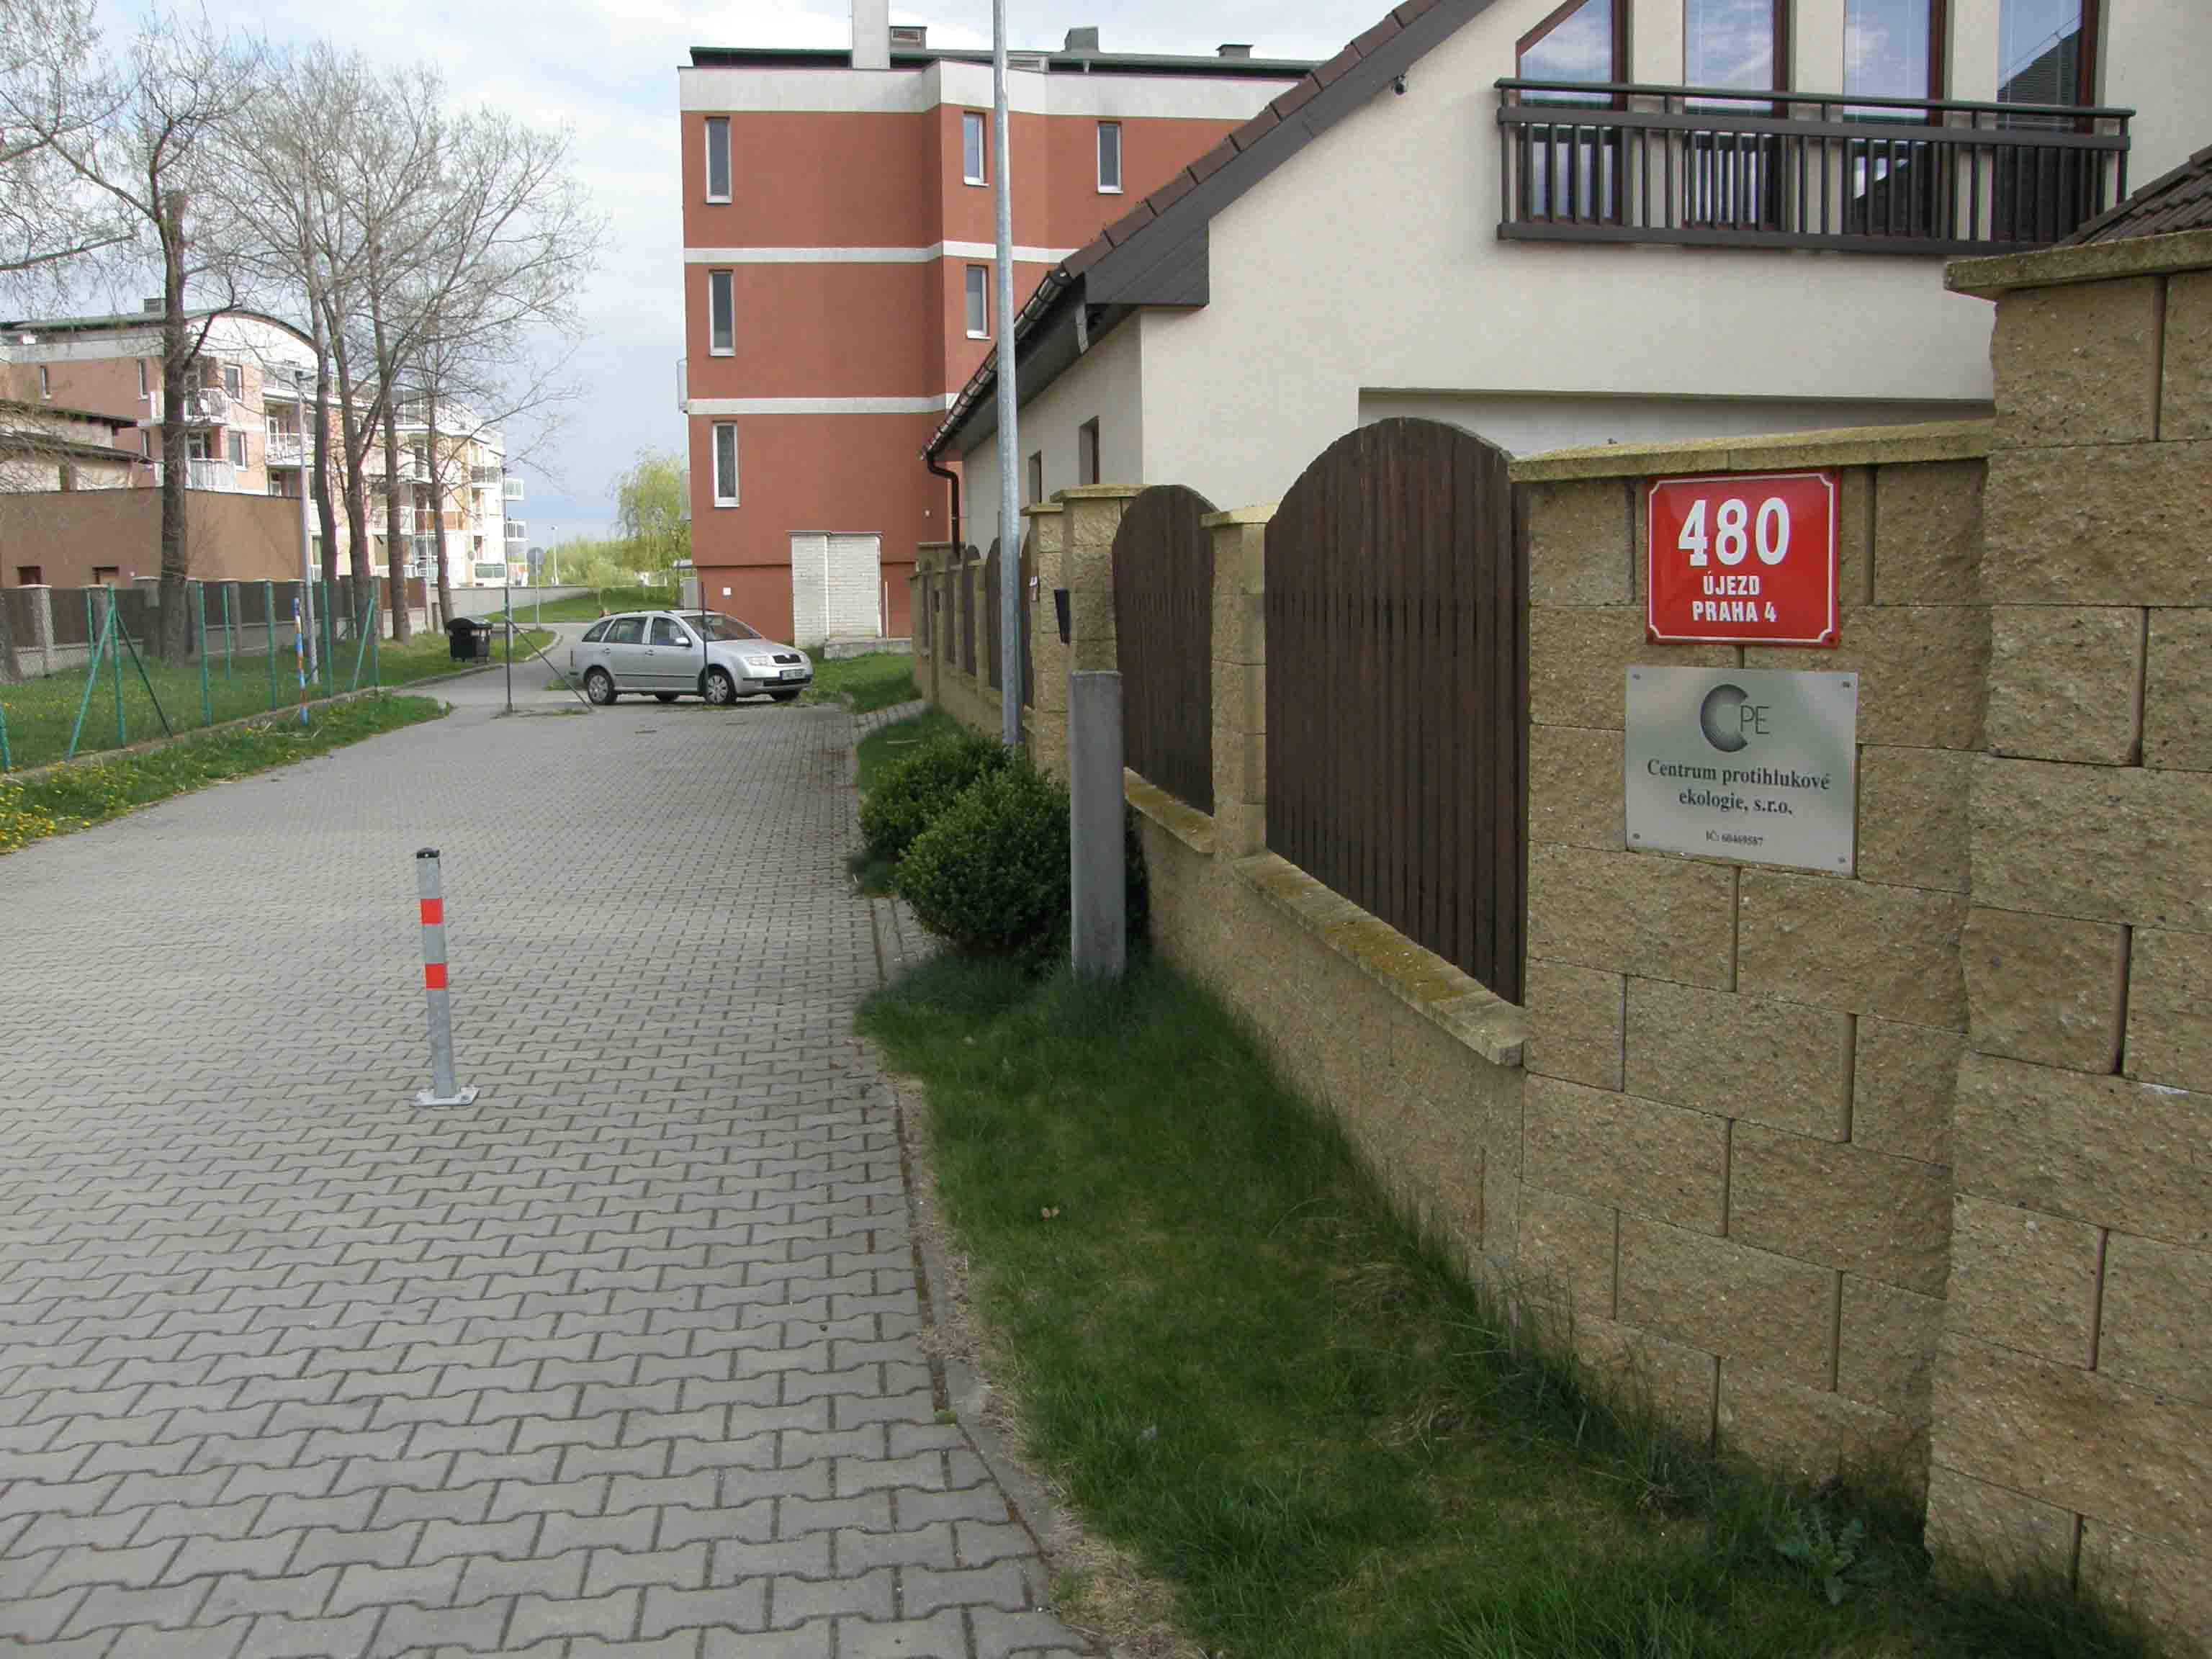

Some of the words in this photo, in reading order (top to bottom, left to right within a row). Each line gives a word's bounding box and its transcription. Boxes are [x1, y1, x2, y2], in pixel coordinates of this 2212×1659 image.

[1678, 497, 1790, 566] 480
[1703, 571, 1760, 595] ÚJEZD
[1693, 601, 1758, 621] PRAHA
[1765, 601, 1777, 622] 4
[1647, 758, 1717, 781] Centrum
[1722, 767, 1831, 791] protihlukové
[1679, 789, 1748, 812] ekologie,
[1753, 797, 1793, 815] s.r.o.
